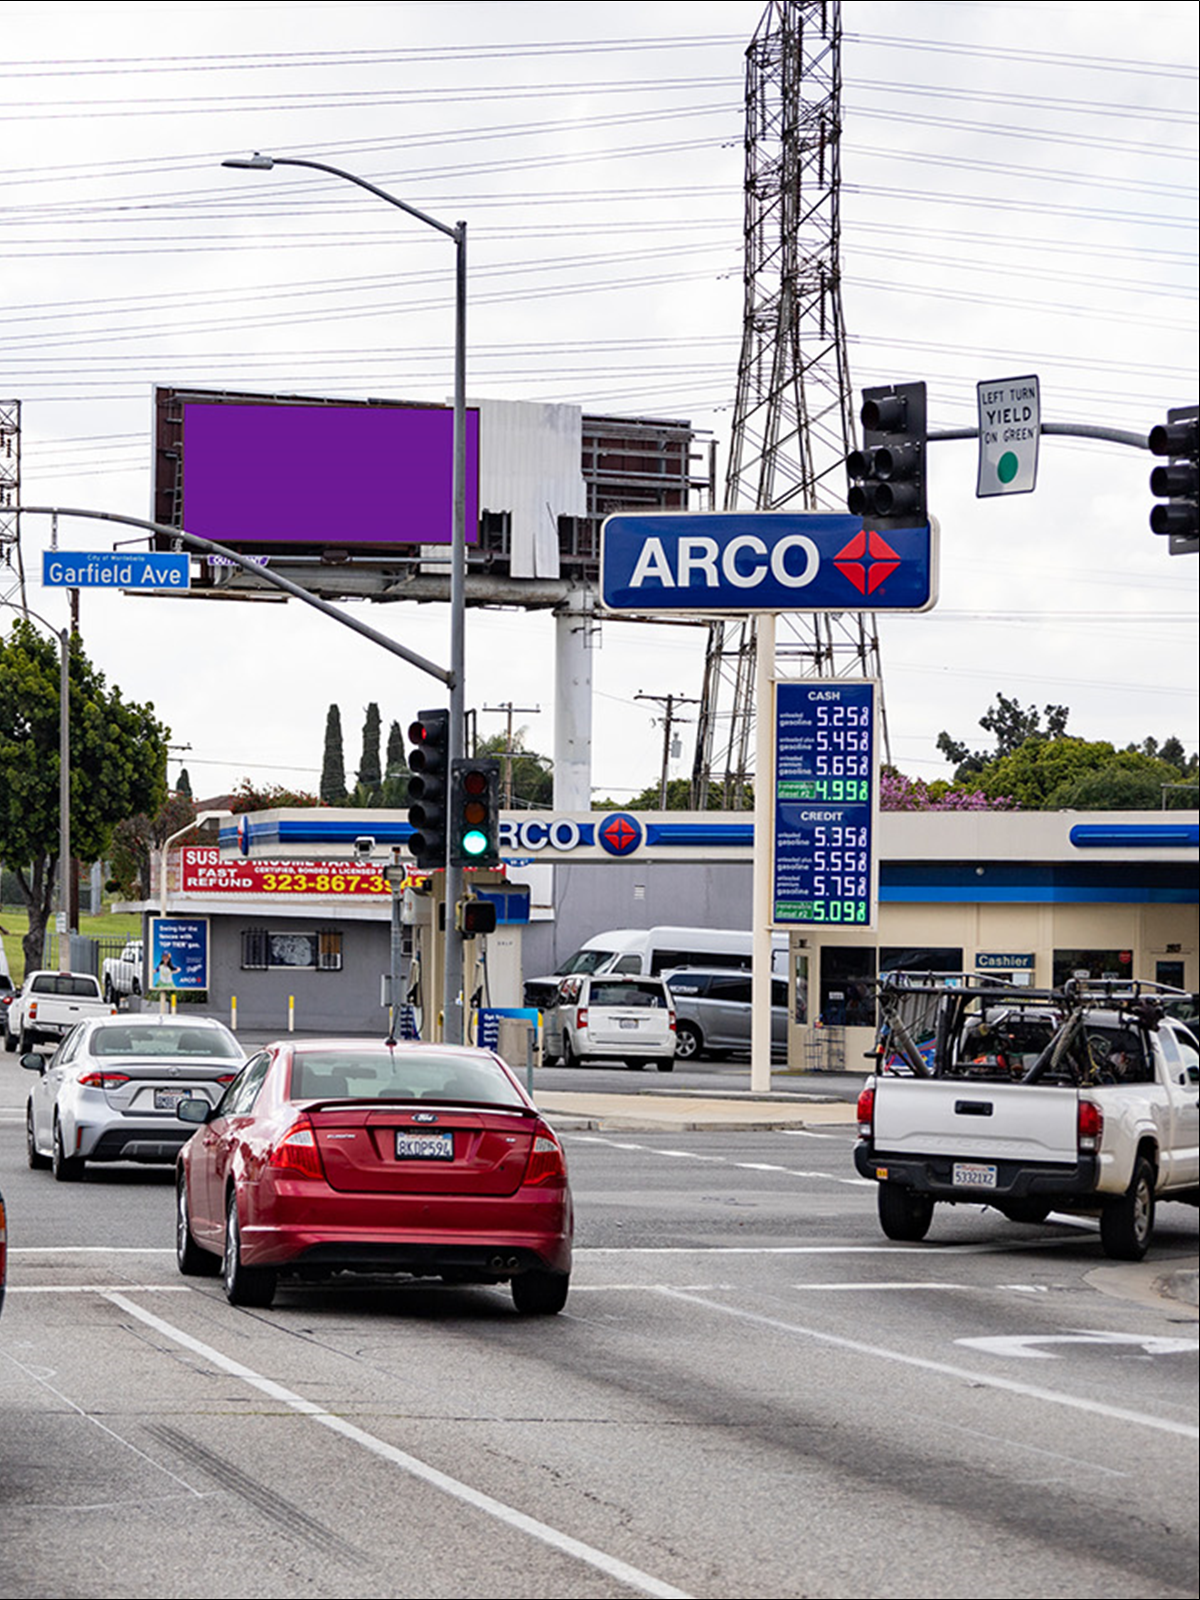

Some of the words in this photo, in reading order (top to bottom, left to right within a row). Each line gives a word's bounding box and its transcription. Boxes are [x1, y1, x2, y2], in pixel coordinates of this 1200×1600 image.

[982, 391, 1004, 405] LEFT
[1010, 387, 1036, 401] TURN
[987, 406, 1032, 425] YIELD
[985, 432, 998, 444] ON
[1004, 427, 1034, 442] GREEN
[87, 554, 100, 562] City
[629, 535, 820, 588] ARCO
[50, 563, 132, 583] Garfield
[141, 565, 181, 584] Ave
[808, 691, 841, 701] CASH
[801, 811, 844, 821] CREDIT
[198, 868, 238, 878] FAST
[188, 878, 253, 887] REFUND
[978, 955, 1028, 967] Cashier
